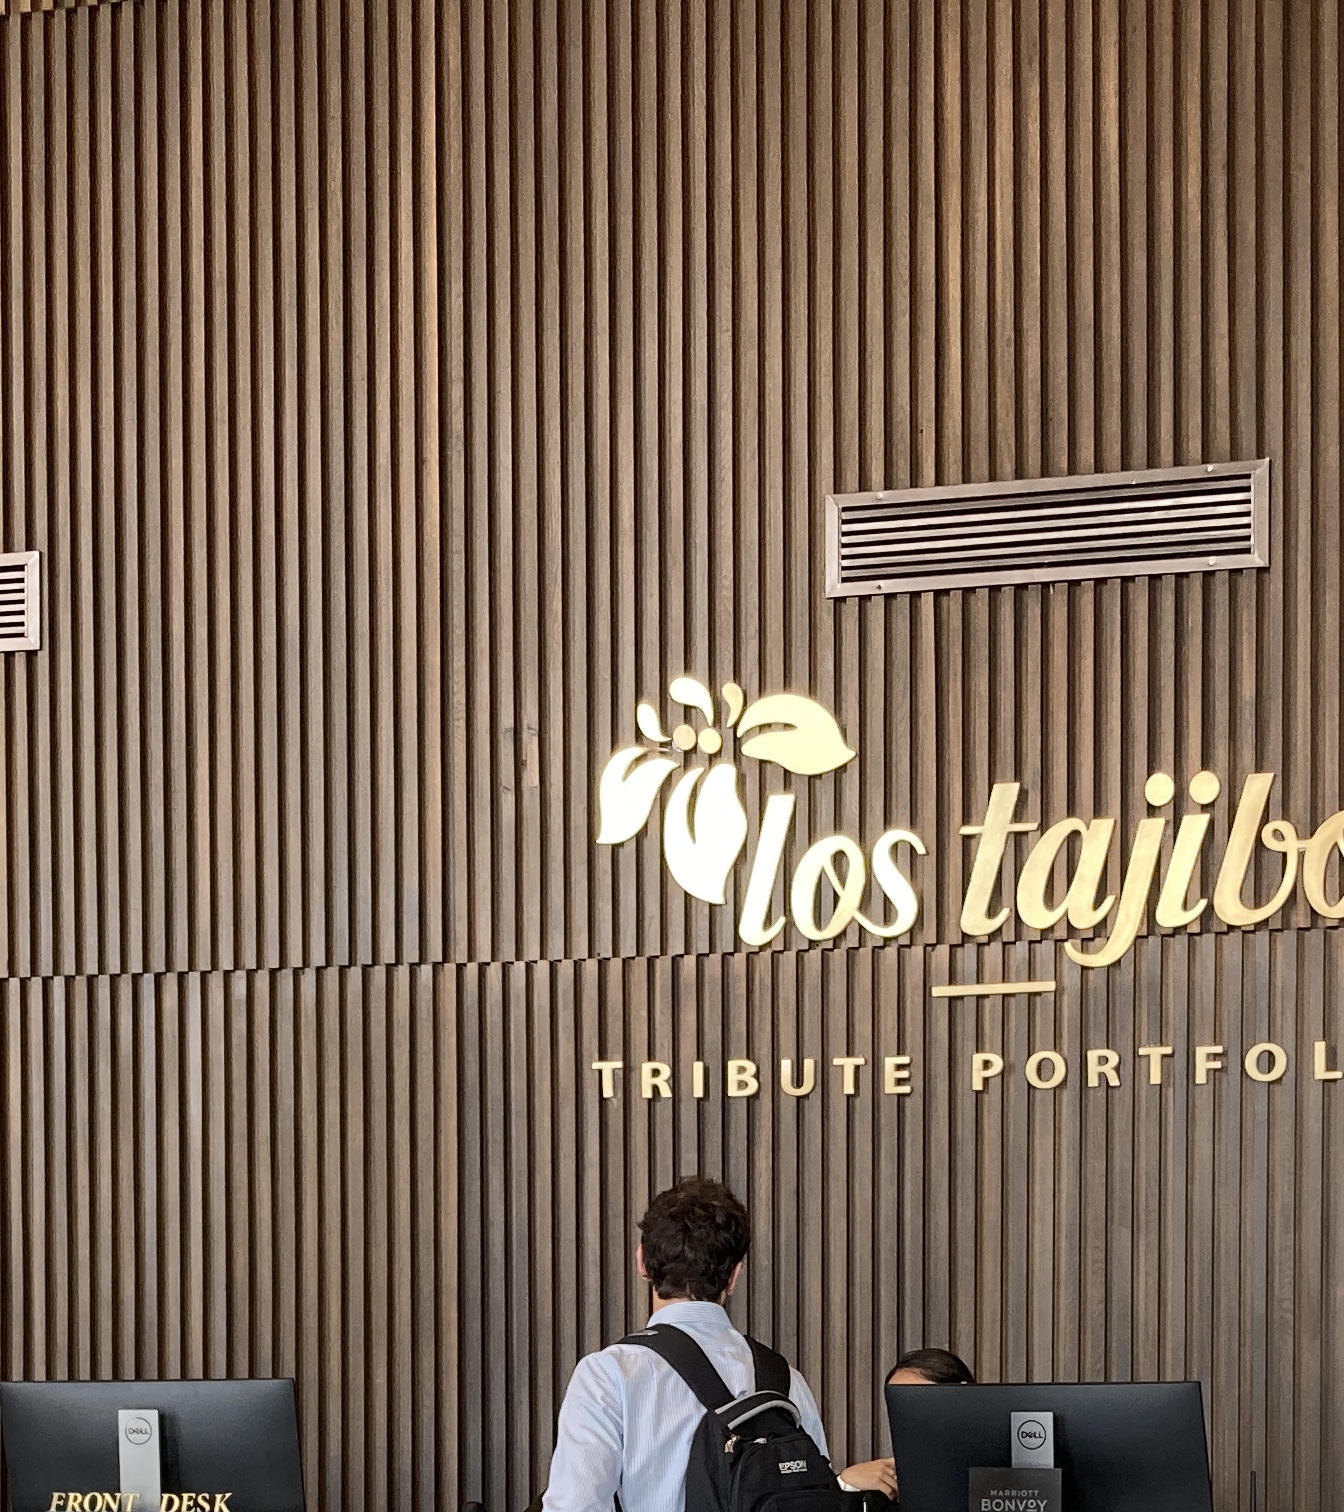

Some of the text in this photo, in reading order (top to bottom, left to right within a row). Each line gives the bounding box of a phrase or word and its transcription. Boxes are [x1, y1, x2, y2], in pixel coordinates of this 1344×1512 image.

[738, 793, 928, 947] los
[592, 1054, 913, 1100] TRIBUTE
[128, 1427, 150, 1435] DELL
[1021, 1430, 1044, 1439] DELL
[778, 1460, 807, 1470] EPSON
[990, 1489, 1040, 1498] MARRIOTT
[981, 1498, 1048, 1512] BONVOY
